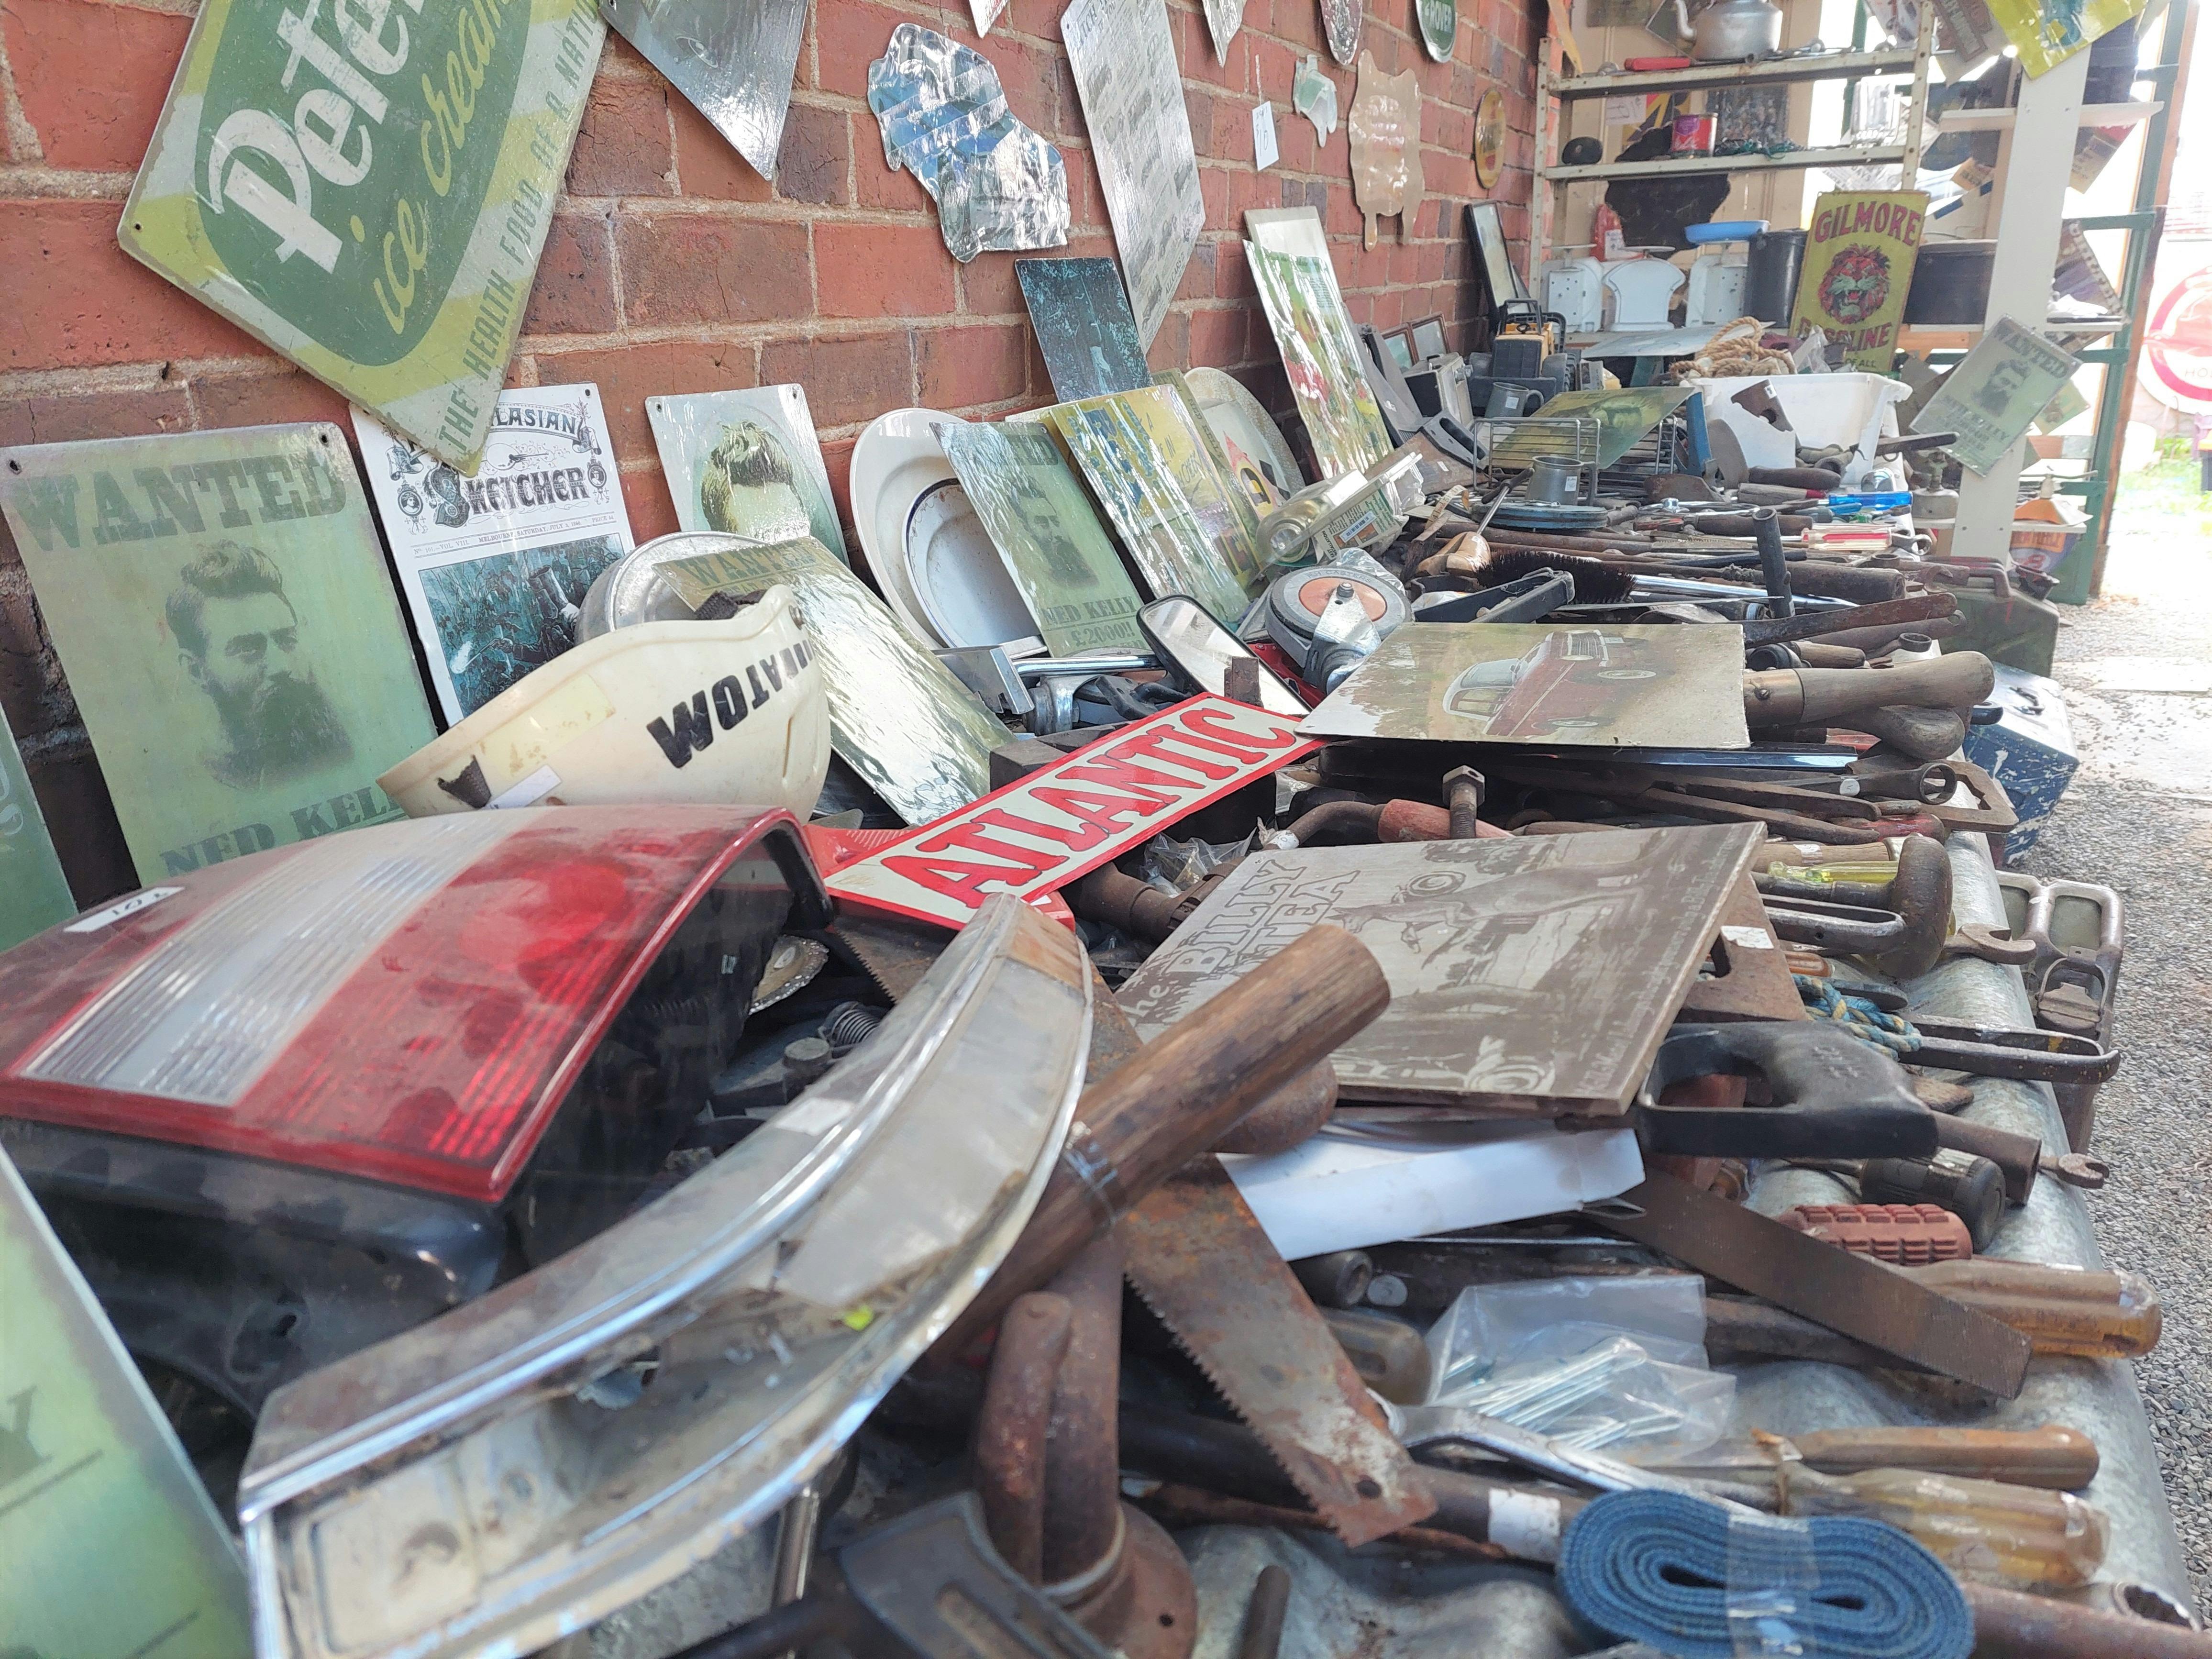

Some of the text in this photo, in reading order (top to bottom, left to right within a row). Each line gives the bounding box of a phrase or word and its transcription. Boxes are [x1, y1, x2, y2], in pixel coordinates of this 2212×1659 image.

[209, 0, 424, 274] Pete
[351, 199, 429, 334] ice
[1814, 201, 1922, 247] GILMORE
[437, 387, 480, 453] THE
[463, 269, 516, 381] HEALTH
[500, 178, 544, 265] FOOD
[530, 122, 559, 170] OF
[545, 90, 572, 123] A
[1799, 317, 1892, 352] GSOLINE
[2185, 367, 2212, 378] HO
[494, 407, 576, 434] LASIAN
[13, 452, 347, 552] WANTED
[550, 523, 564, 531] JULY
[1042, 596, 1137, 625] NED KELLY
[1071, 621, 1136, 646] £2000!!
[646, 654, 784, 769] ATOM
[159, 785, 402, 877] NED KEL
[881, 707, 1296, 909] ATLANTIC
[1135, 859, 1308, 1024] he BILLY
